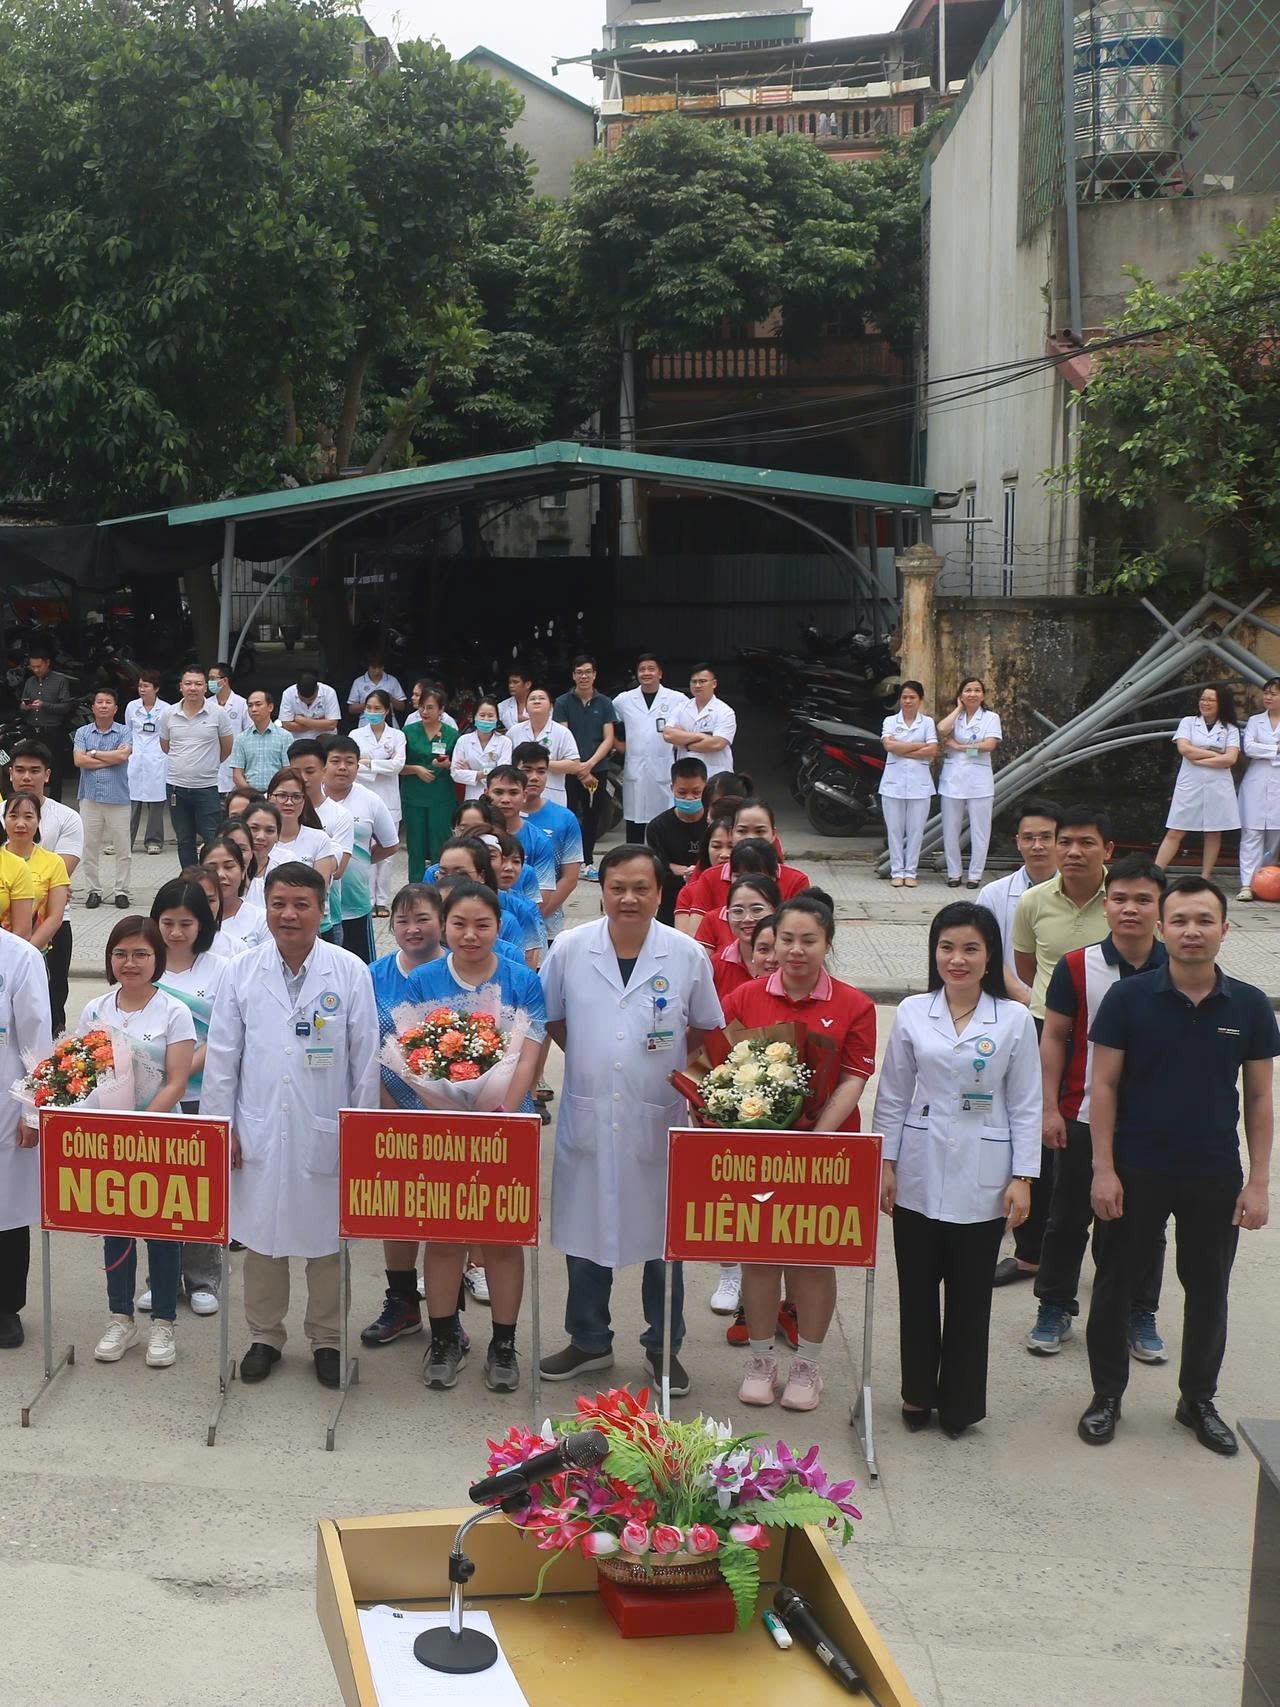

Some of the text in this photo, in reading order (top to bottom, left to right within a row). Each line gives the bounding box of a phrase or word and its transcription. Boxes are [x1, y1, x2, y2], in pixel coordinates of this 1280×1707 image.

[62, 1126, 206, 1167] CÔNG ĐOÀN KHỐI
[375, 1127, 508, 1164] CÔNG ĐOÀN KHỐI
[711, 1147, 851, 1185] CÔNG ĐOÀN KHỐI
[58, 1166, 210, 1231] NGOẠI
[349, 1170, 531, 1227] KHÁM BỆNH CẤP CỨU
[684, 1193, 863, 1247] LIÊN KHOA
